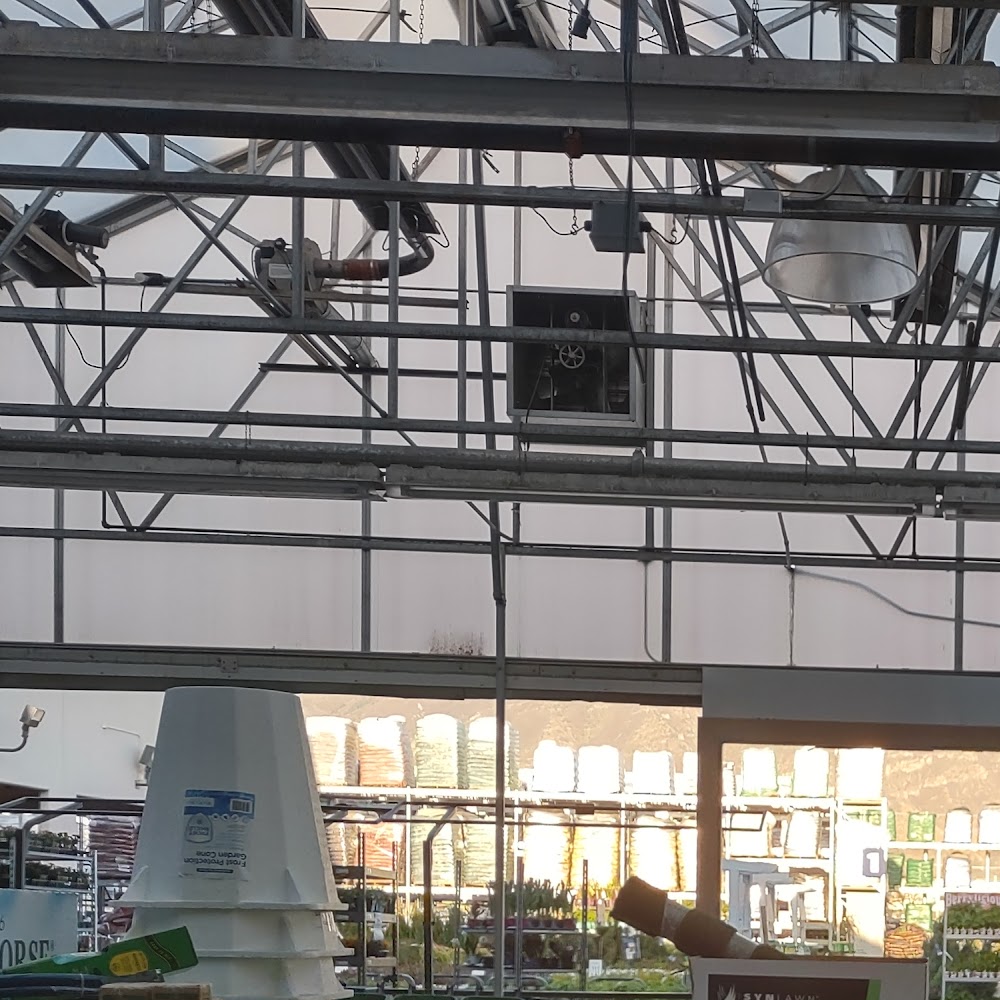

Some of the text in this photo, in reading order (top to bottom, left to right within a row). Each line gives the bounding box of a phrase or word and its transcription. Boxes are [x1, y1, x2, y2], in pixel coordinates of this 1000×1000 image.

[217, 851, 247, 860] Garden
[183, 857, 247, 867] Frost Protection
